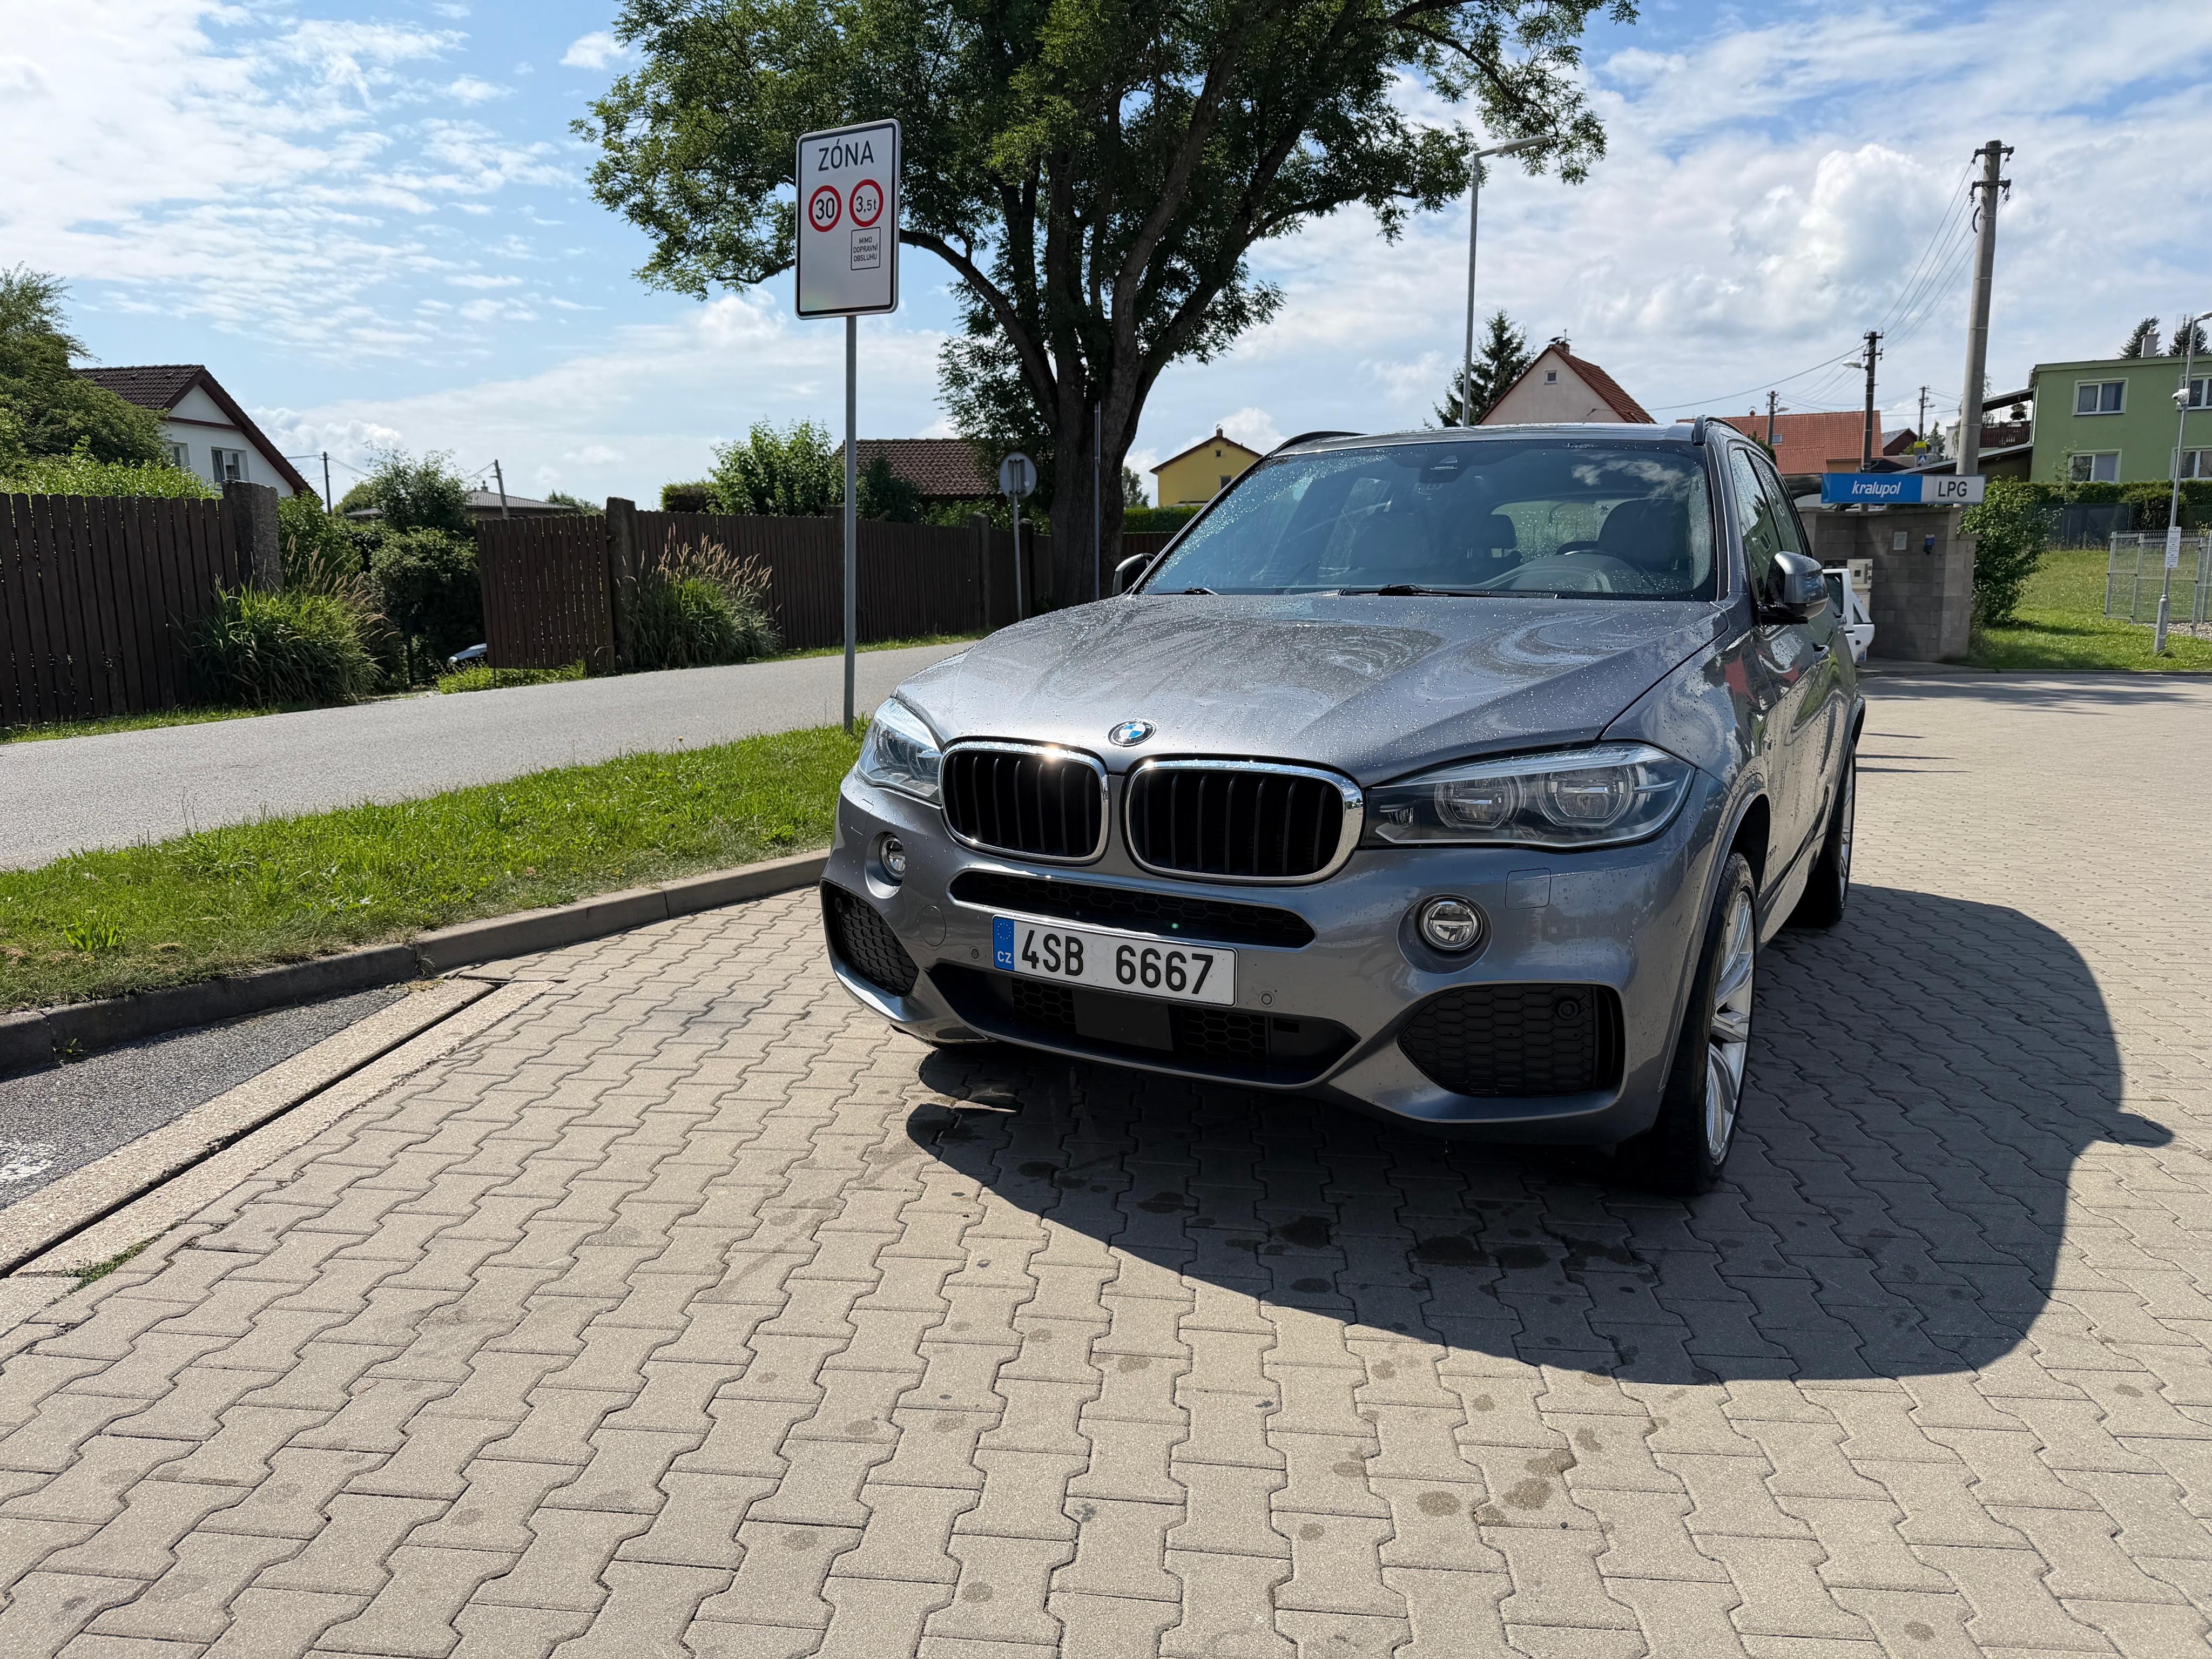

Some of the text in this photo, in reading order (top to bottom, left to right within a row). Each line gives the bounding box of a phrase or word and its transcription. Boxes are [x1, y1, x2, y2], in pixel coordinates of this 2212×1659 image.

[818, 138, 874, 171] ZÓNA
[815, 198, 835, 220] 30
[853, 242, 878, 253] DOPRAVNÍ
[859, 236, 872, 244] MIMO
[853, 253, 877, 262] OBSLUHU
[1851, 481, 1901, 498] kralupol
[1938, 481, 1967, 497] LPG
[997, 950, 1012, 965] CZ
[1022, 929, 1214, 995] 4SB 6667
